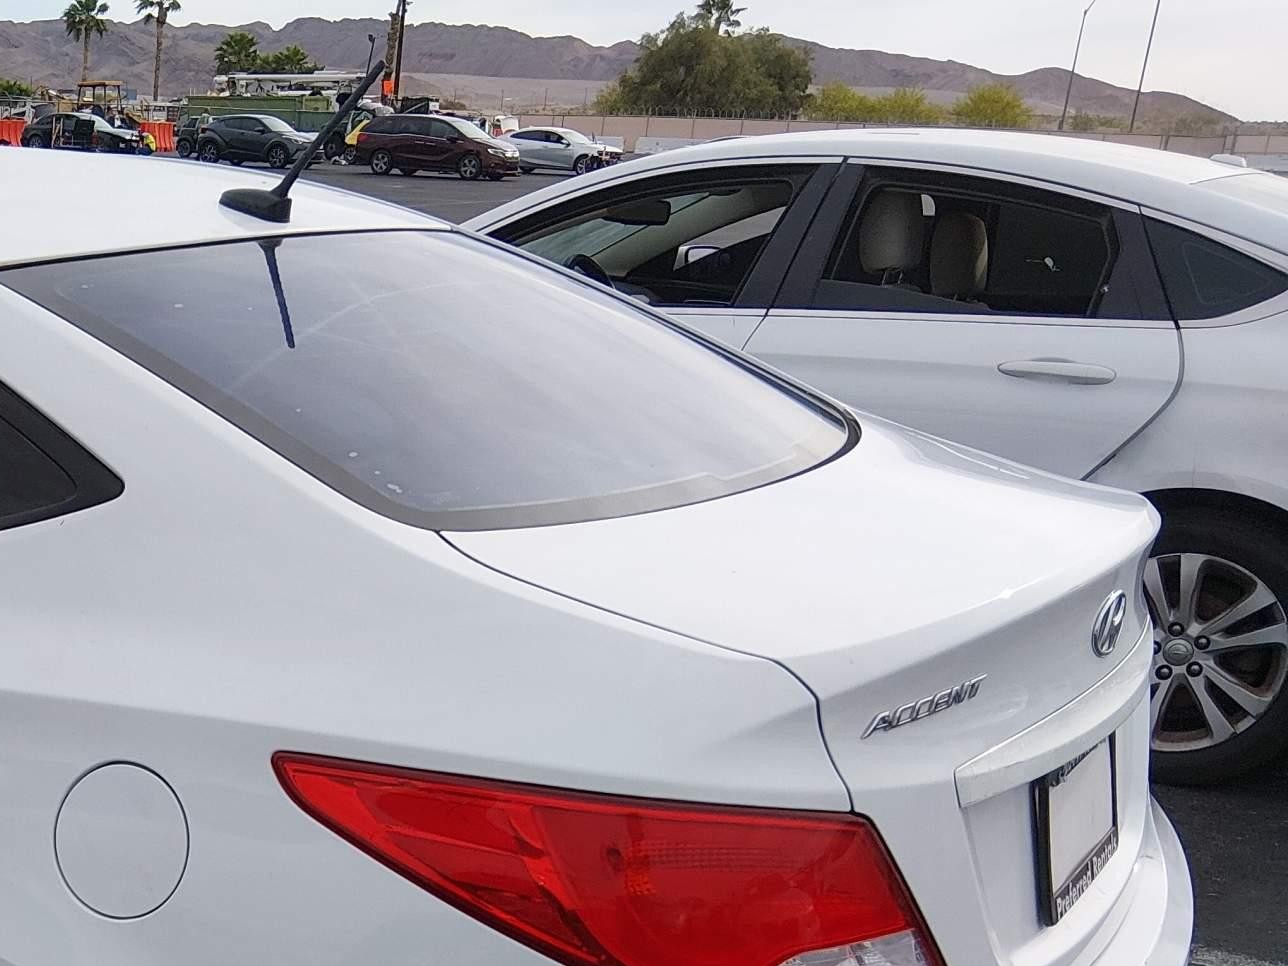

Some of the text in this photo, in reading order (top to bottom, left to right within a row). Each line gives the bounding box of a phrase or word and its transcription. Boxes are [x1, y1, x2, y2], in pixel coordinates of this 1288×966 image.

[860, 673, 989, 739] ACCENT
[1056, 832, 1117, 920] Preferred Rentals
